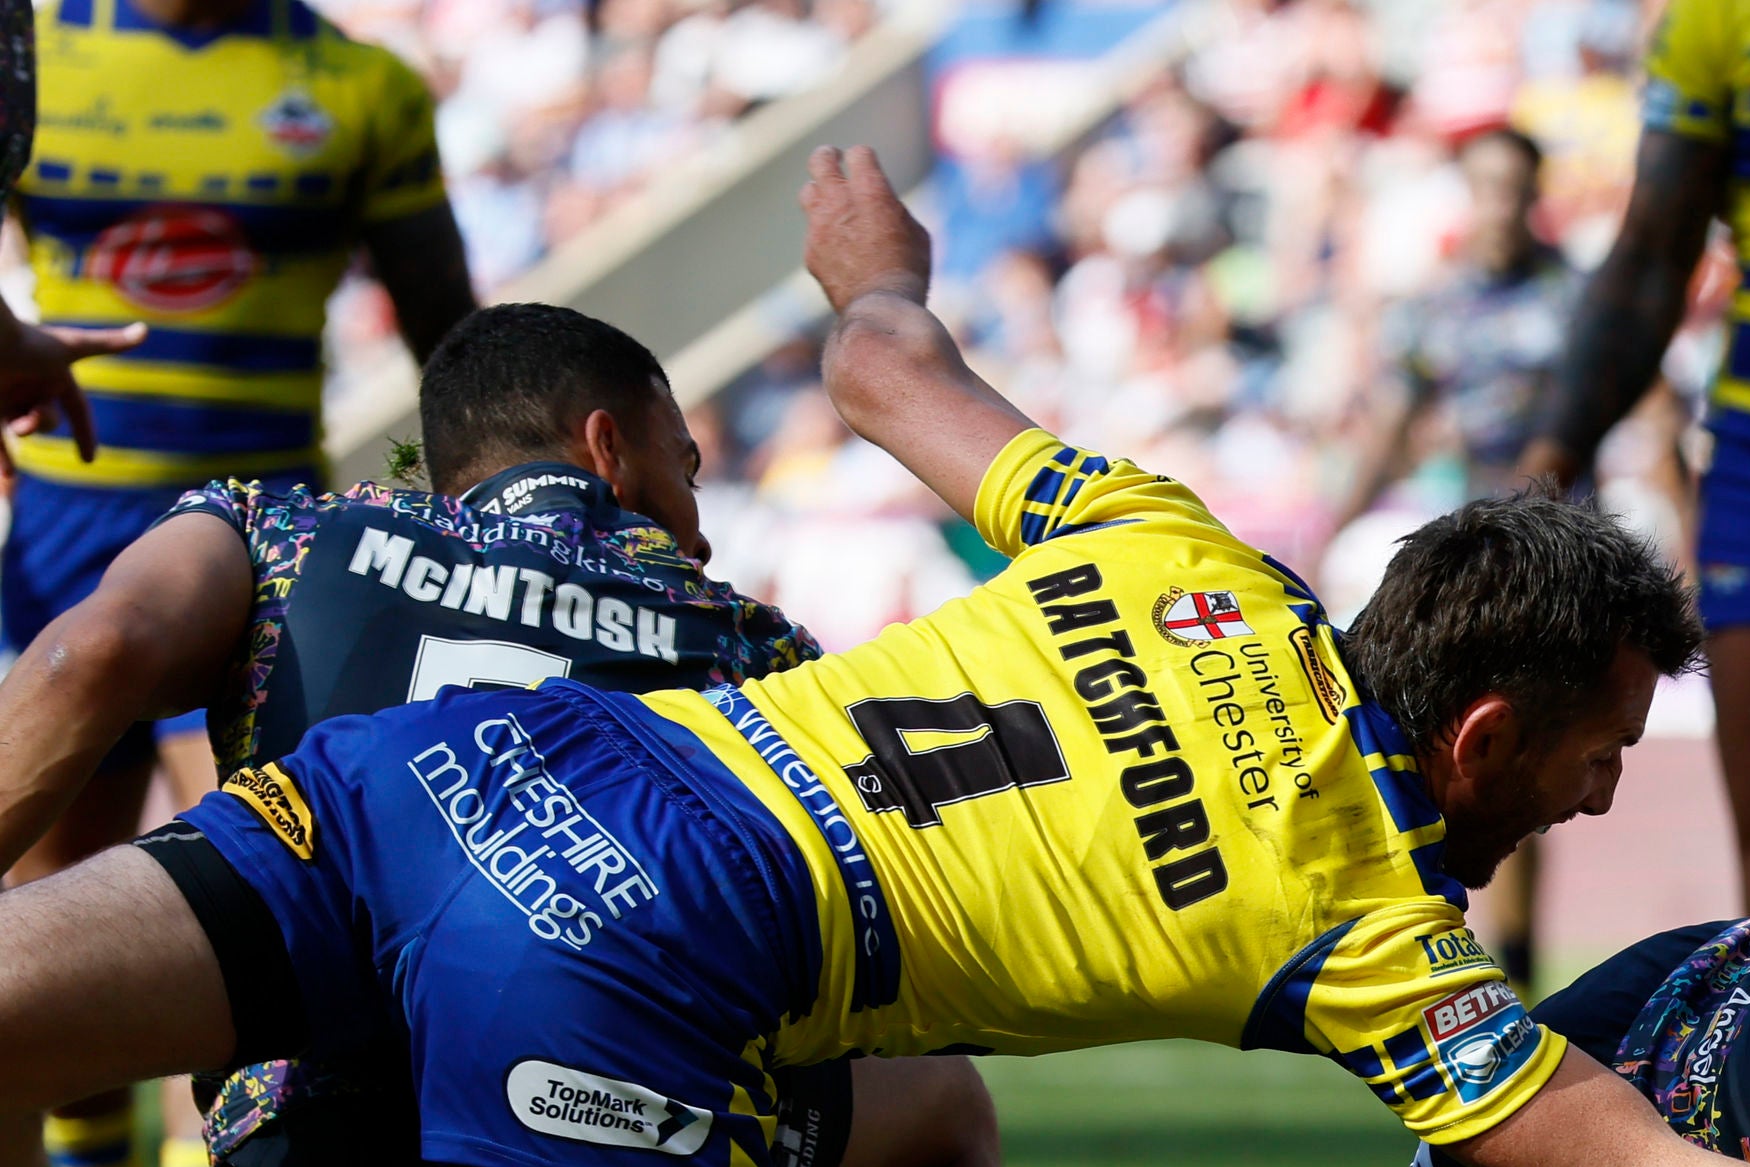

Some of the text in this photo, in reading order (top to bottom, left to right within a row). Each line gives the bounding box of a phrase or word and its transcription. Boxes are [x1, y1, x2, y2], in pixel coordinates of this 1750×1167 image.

[502, 474, 590, 506] SUMMIT
[507, 494, 533, 514] VANS
[842, 692, 1073, 828] 4
[1026, 562, 1230, 911] RATCHFORD
[1190, 650, 1279, 812] Chester
[1239, 643, 1319, 799] University of
[412, 741, 604, 948] mouldings
[473, 718, 653, 920] CHESHIRE
[529, 1096, 645, 1133] Solutions
[548, 1079, 647, 1116] TopMark
